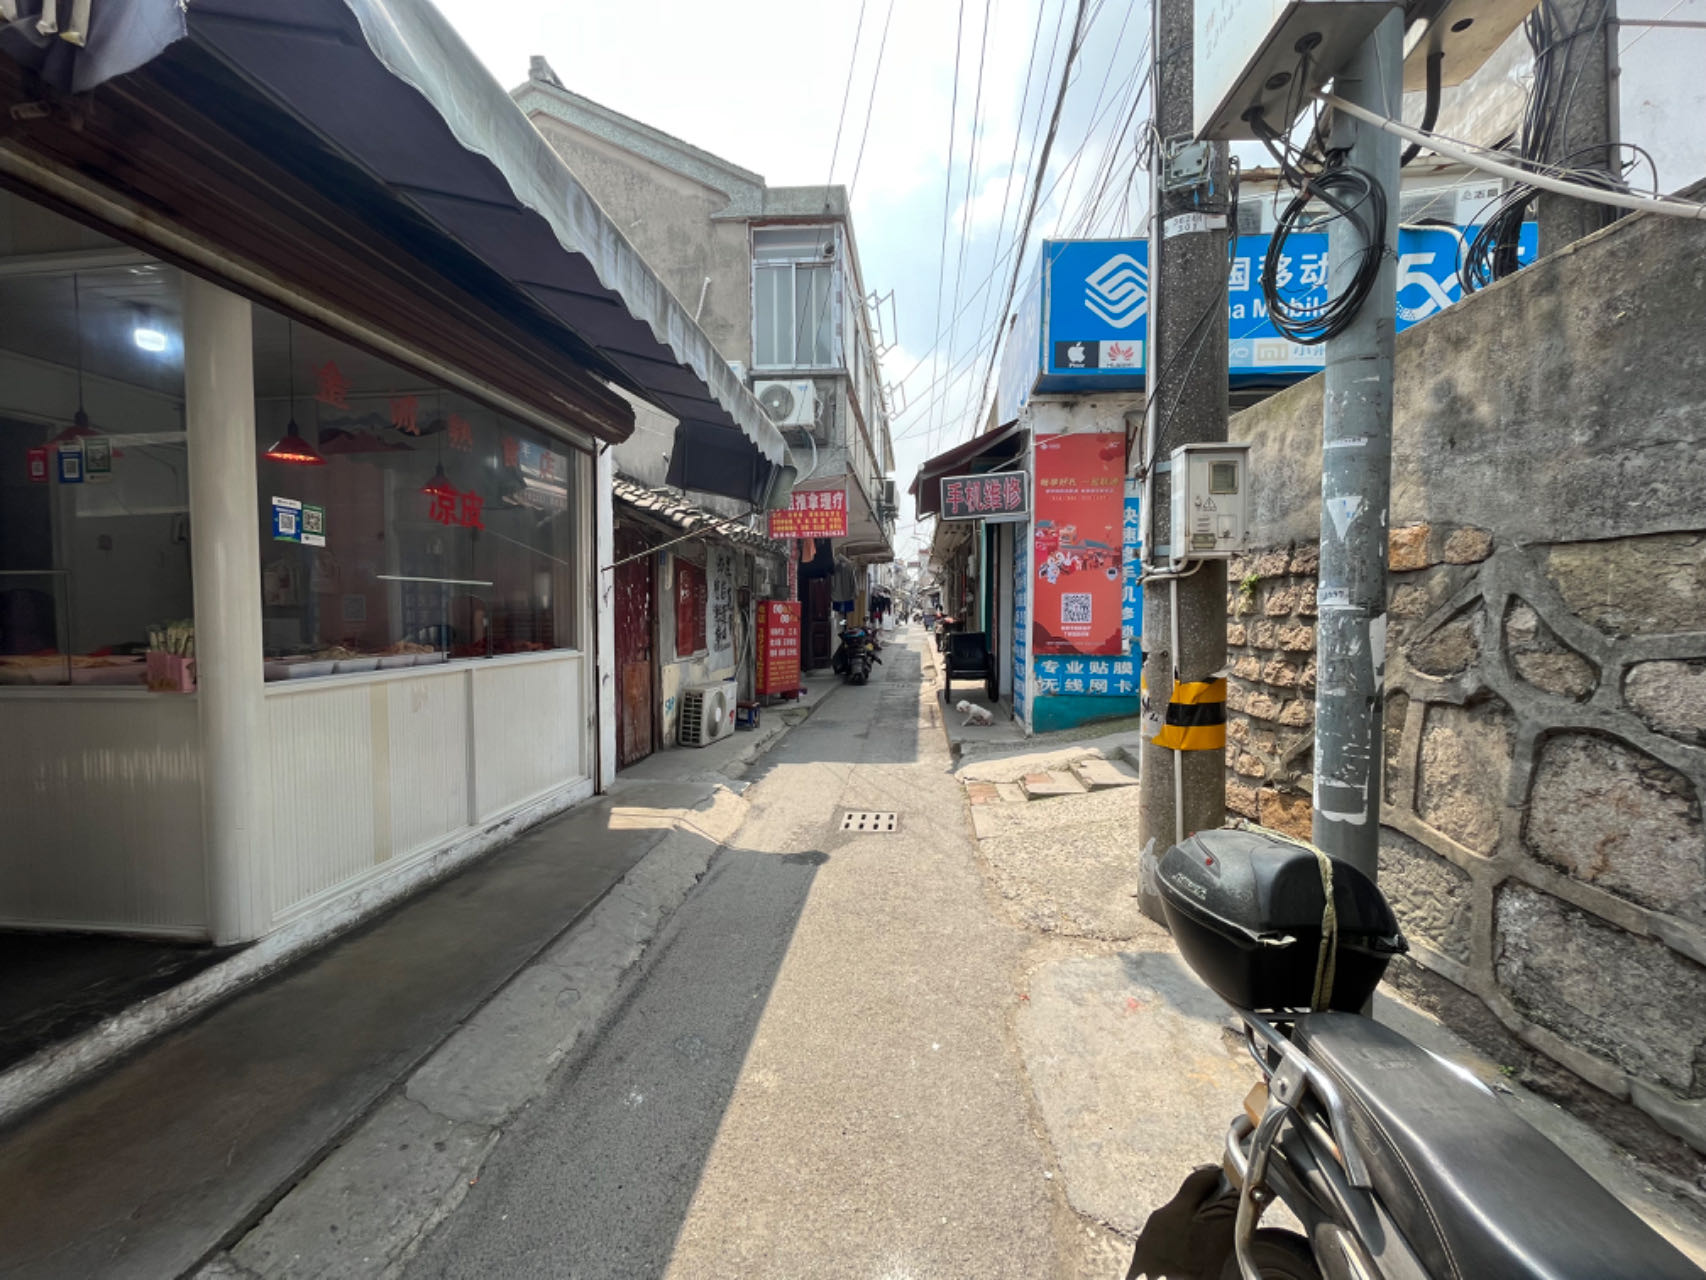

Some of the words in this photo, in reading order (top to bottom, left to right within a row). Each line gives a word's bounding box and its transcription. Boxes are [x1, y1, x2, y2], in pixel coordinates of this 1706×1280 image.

[429, 485, 485, 531] 凉皮
[946, 477, 1022, 514] 手机维修
[1041, 660, 1134, 675] 专业贴膜
[1041, 678, 1133, 693] 无线网卡
